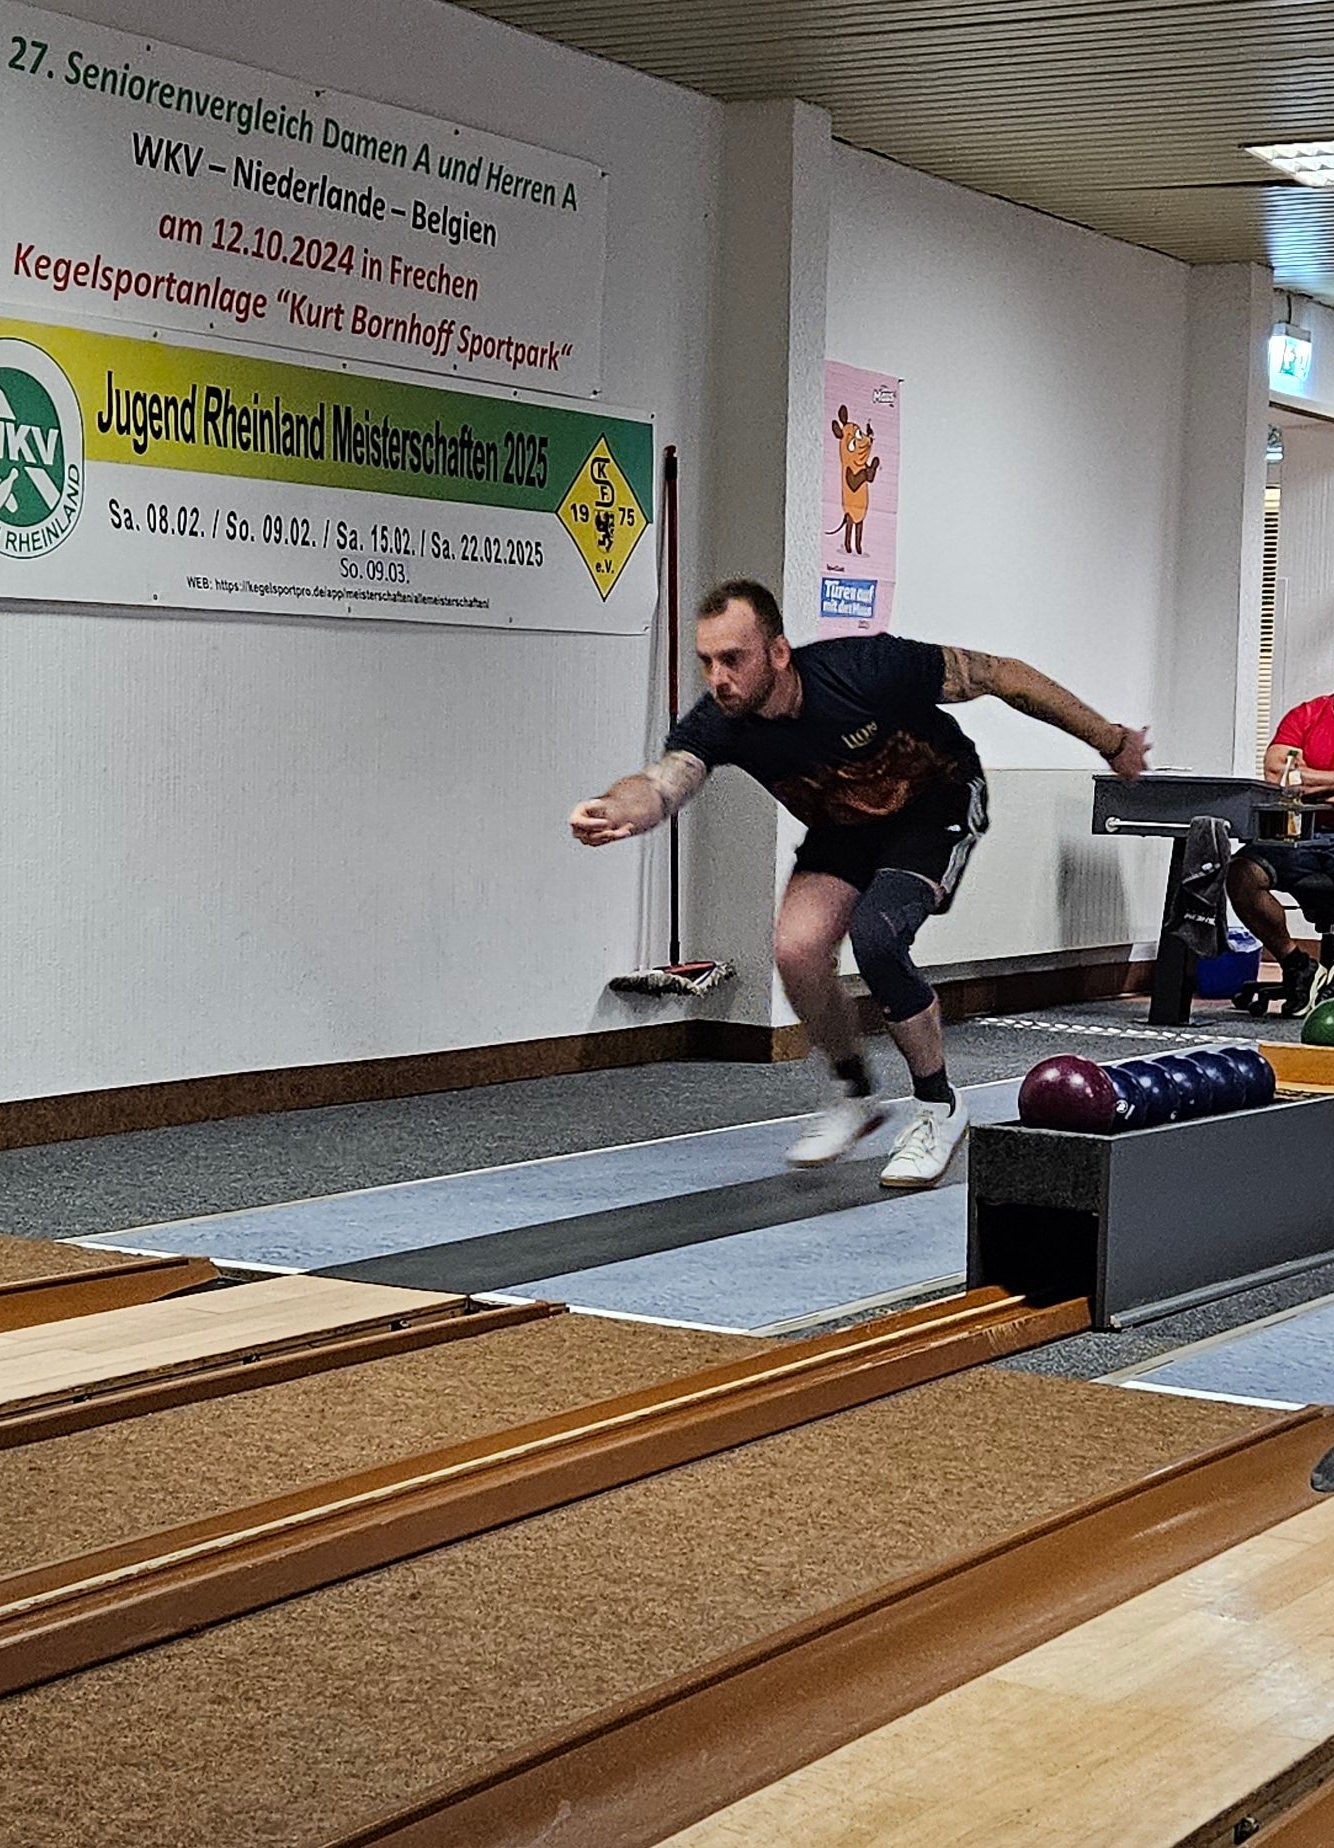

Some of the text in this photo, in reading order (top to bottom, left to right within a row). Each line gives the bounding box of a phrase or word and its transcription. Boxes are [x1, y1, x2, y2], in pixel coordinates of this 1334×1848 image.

[7, 36, 577, 211] 27. Seniorenvergleich Damen A und Herren A
[132, 132, 204, 178] WKV
[233, 156, 386, 221] Niederlande
[411, 200, 496, 247] Belgien
[13, 242, 268, 324] Kegelsportanlage
[351, 304, 455, 356] Bornhoff
[158, 213, 479, 301] am 12.10.2024 in Frechen
[97, 370, 549, 489] Jugend Rheinland Meisterschaften 2025
[5, 463, 80, 553] RHEINLAND
[108, 498, 141, 531] Sa.
[146, 503, 205, 537] 08.02.
[212, 509, 220, 539] /
[225, 510, 255, 542] So.
[262, 514, 317, 548] 09.02.
[323, 519, 331, 548] /
[336, 520, 364, 551] Sa.
[371, 524, 416, 556] 15.02.
[431, 531, 456, 560] Sa.
[460, 533, 544, 567] 22.02.2025
[570, 502, 635, 527] 19 75
[186, 576, 213, 590] WEB:
[339, 557, 410, 584] So. 09.03.
[595, 558, 615, 574] e.V.
